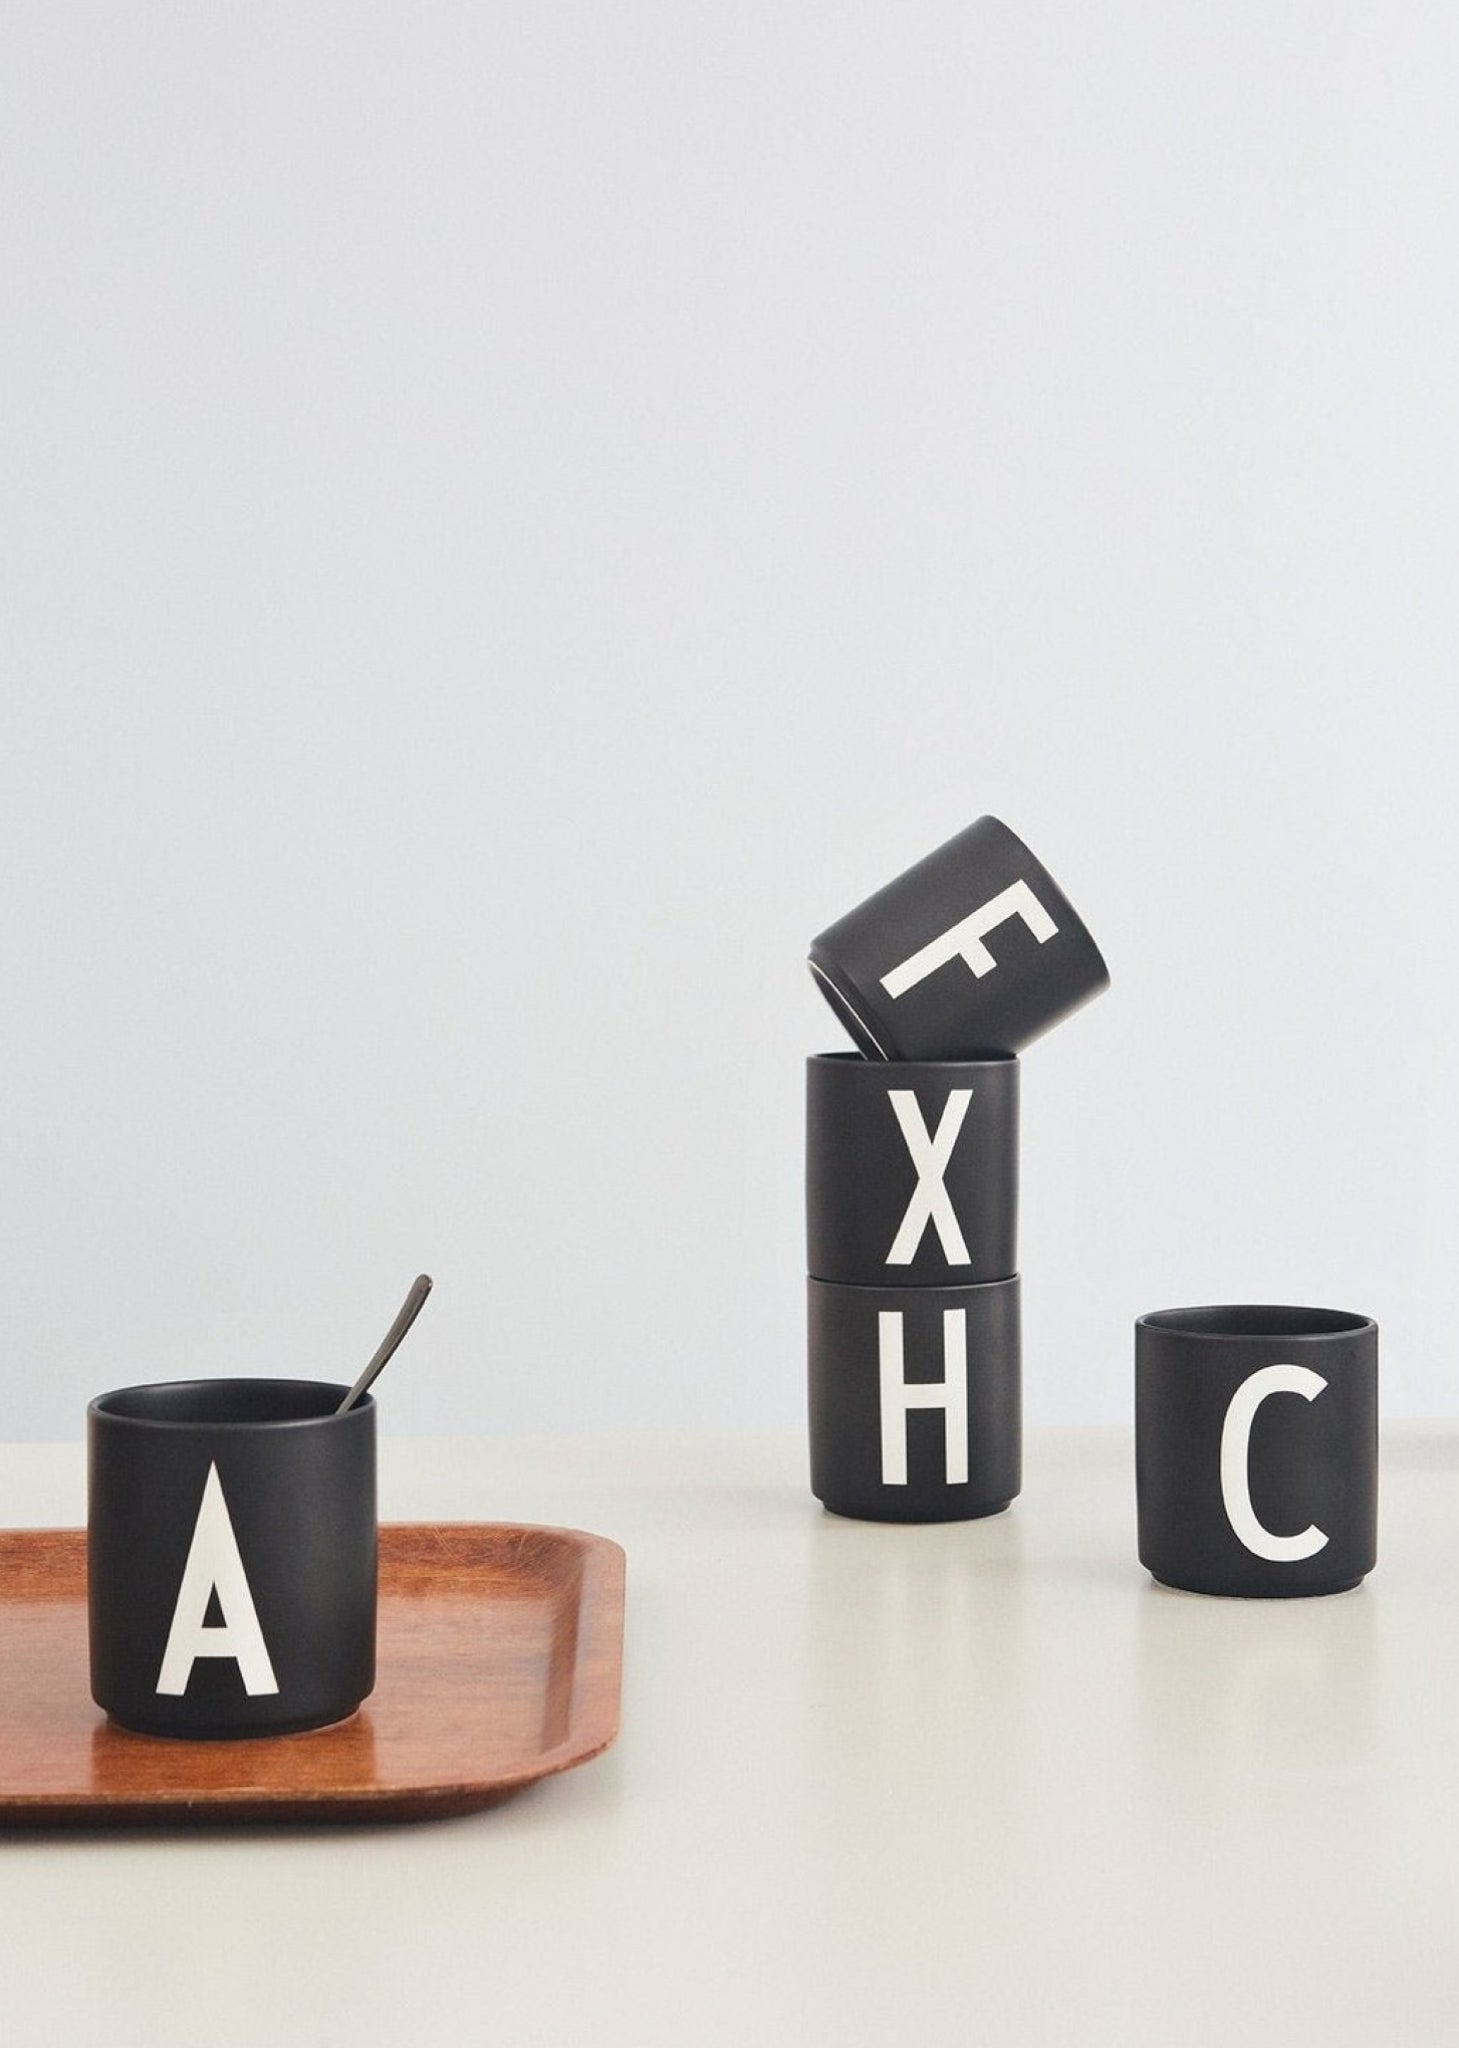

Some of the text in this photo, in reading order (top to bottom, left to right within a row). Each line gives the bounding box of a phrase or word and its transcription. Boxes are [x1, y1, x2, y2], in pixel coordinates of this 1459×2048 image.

[880, 879, 1060, 999] F
[886, 1089, 974, 1266] X
[878, 1309, 969, 1486] H
[1221, 1364, 1329, 1562] C
[156, 1460, 280, 1697] A
